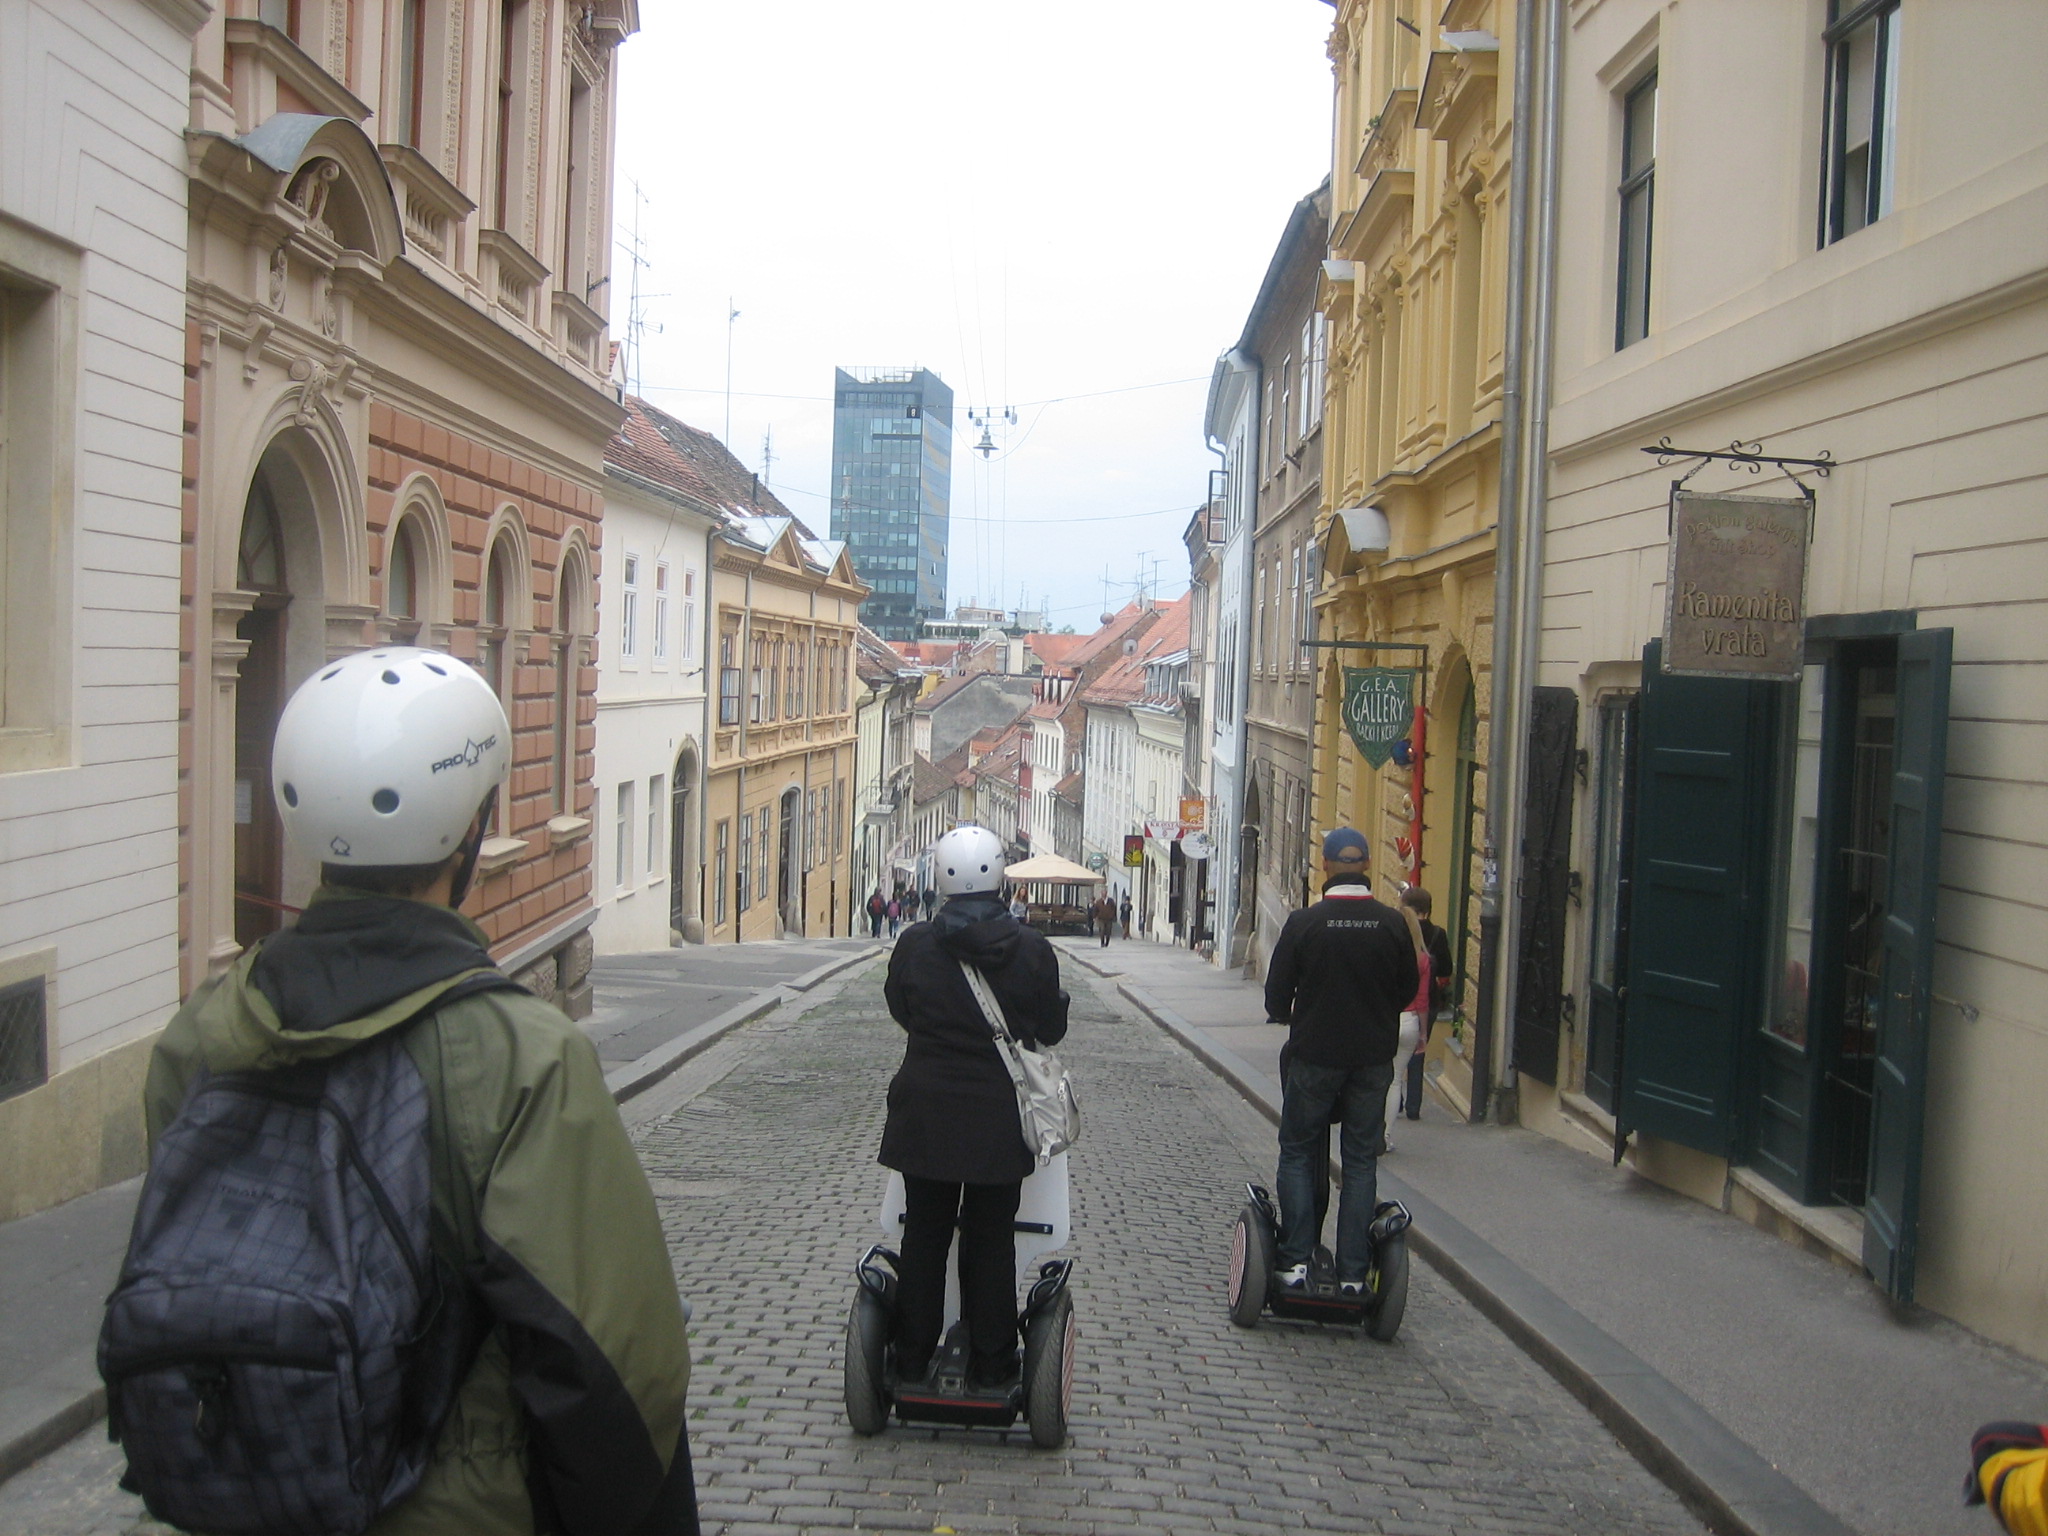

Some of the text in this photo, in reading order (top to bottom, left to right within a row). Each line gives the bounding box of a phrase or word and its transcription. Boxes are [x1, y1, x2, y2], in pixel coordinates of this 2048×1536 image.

[1677, 581, 1796, 623] Kamenita
[1702, 624, 1767, 657] vrata
[1360, 677, 1400, 693] G.E.A.
[1351, 691, 1405, 723] GALLERY
[432, 735, 497, 774] PRO TEC
